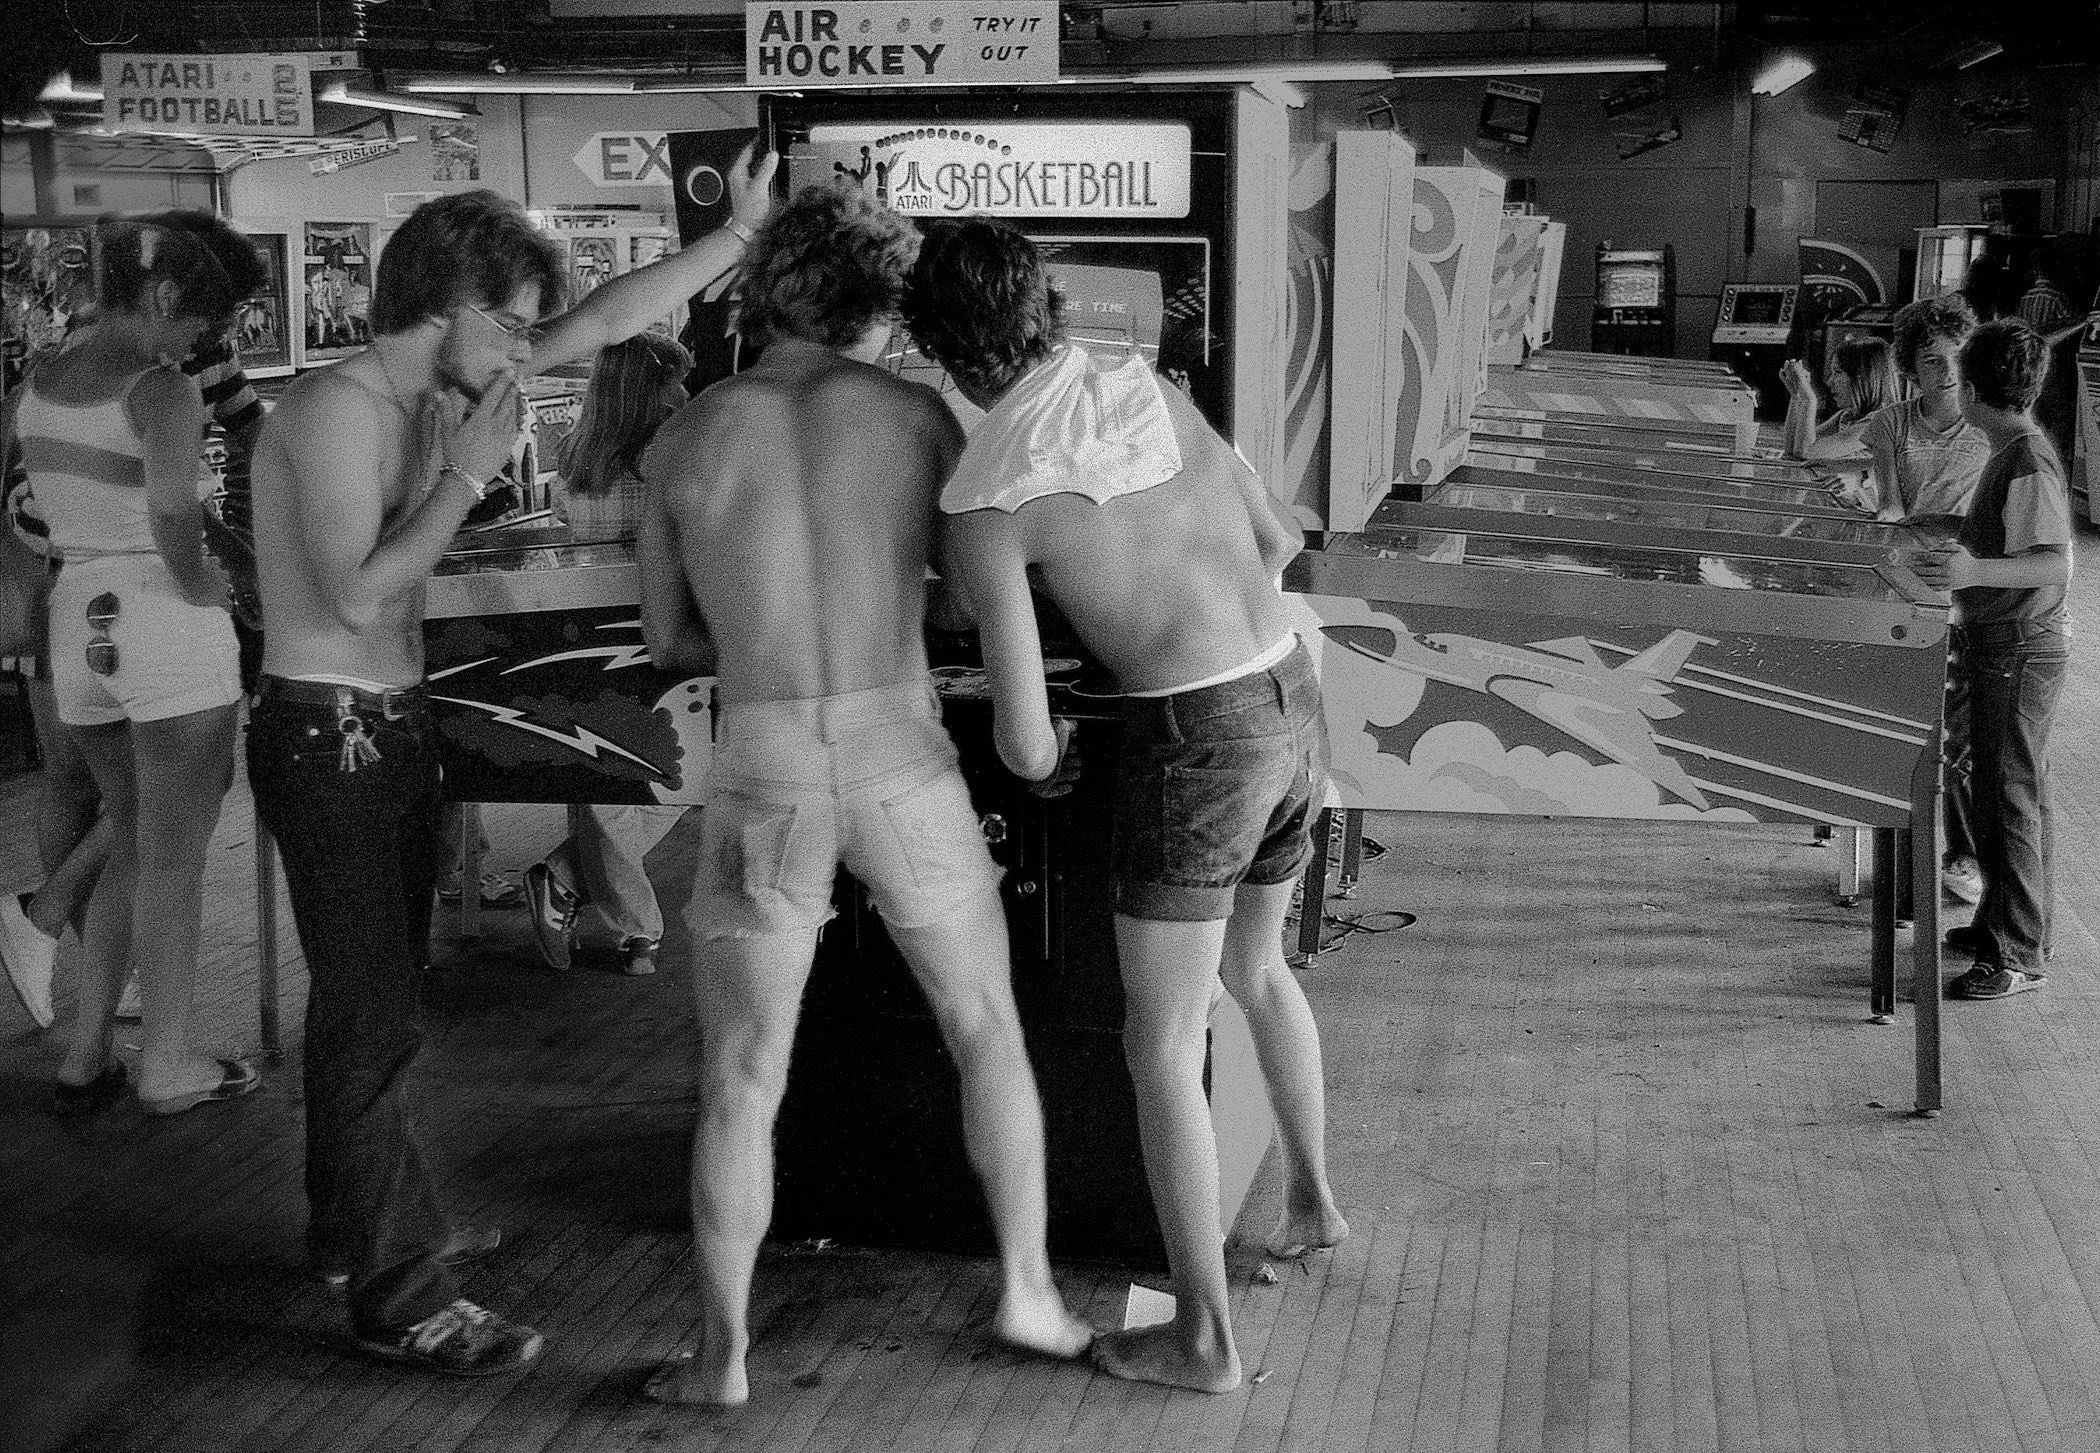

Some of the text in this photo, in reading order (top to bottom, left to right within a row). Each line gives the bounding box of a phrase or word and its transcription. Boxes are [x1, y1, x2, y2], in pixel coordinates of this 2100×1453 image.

[759, 9, 839, 42] AIR
[973, 17, 1042, 32] TRY IT
[758, 44, 946, 77] HOCKEY
[981, 46, 1029, 61] OUT
[118, 62, 214, 89] ATARI
[118, 98, 275, 126] FOOTBALL
[935, 160, 1157, 211] BASKETBALL
[896, 195, 933, 210] ATARI
